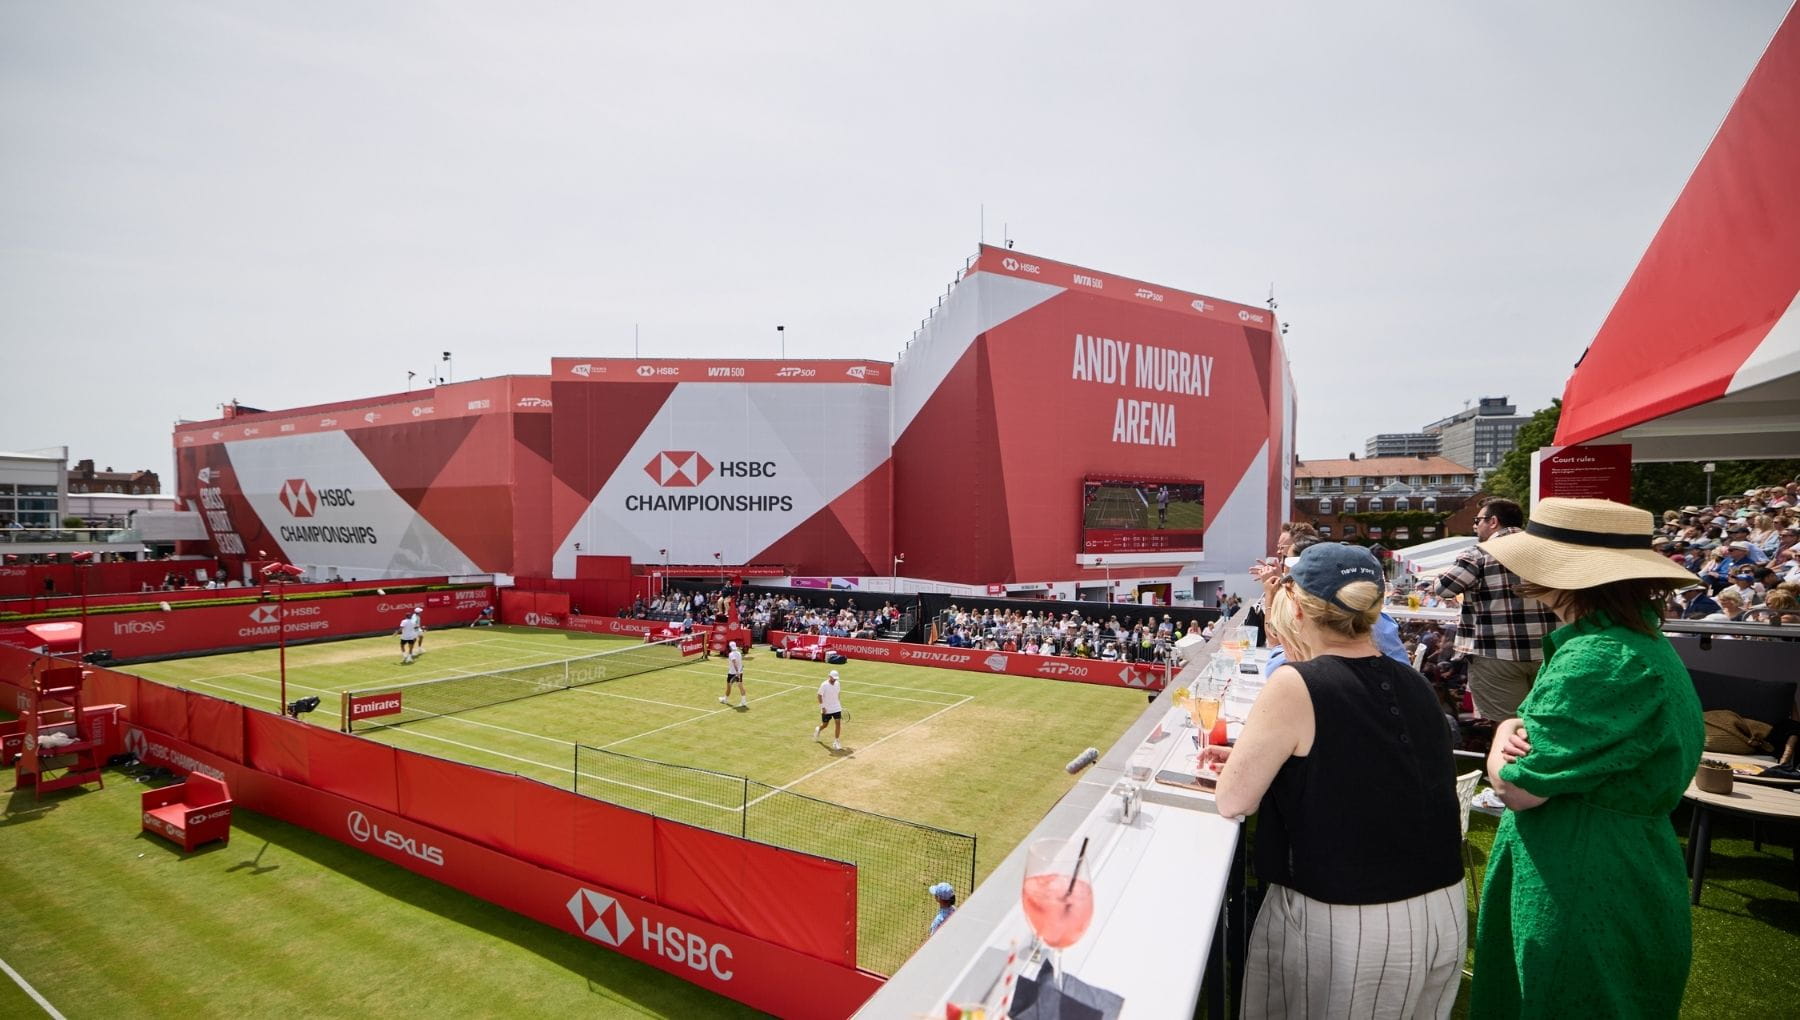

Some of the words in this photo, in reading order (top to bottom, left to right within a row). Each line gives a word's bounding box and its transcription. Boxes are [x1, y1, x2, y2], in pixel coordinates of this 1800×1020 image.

[1020, 262, 1041, 275] HSBC
[656, 367, 680, 375] HSBC
[1072, 334, 1130, 386] ANDY
[1135, 344, 1214, 397] MURRAY
[1112, 398, 1176, 447] ARENA
[720, 461, 777, 478] HSBC
[318, 488, 355, 507] HSBC
[625, 495, 793, 512] CHAMPIONSHIPS
[280, 525, 377, 544] CHAMPIONSHIPS
[1340, 567, 1358, 576] new
[291, 606, 321, 616] HSBC
[113, 620, 167, 635] Infosys
[238, 620, 329, 636] CHAMPONSHIPS
[620, 623, 650, 632] LEXUS
[831, 644, 890, 656] HAMPIONSHIPS
[911, 650, 971, 663] DUNLOP
[353, 699, 400, 714] Emirates
[373, 824, 444, 866] LEXUS
[642, 917, 733, 981] HSBC
